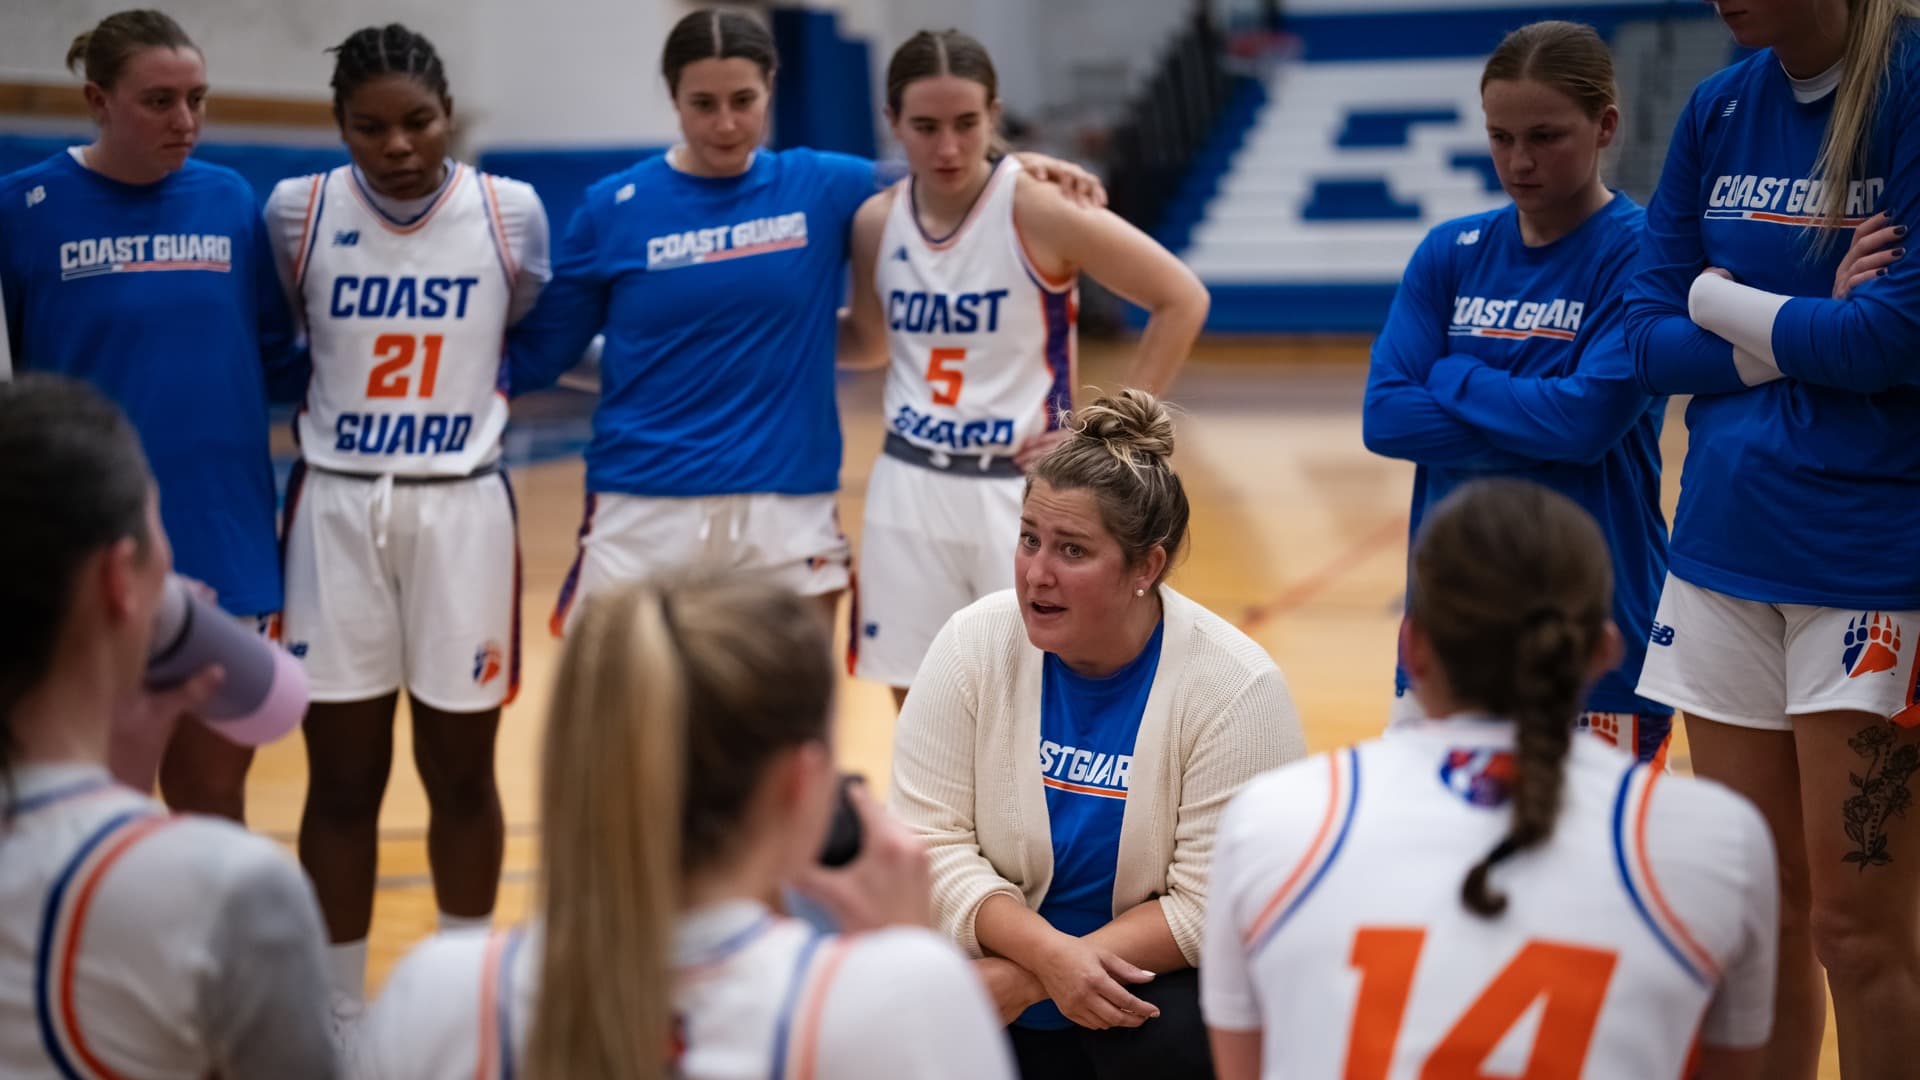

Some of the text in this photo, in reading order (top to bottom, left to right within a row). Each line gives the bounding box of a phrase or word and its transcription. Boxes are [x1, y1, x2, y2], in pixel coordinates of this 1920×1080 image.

[1708, 175, 1885, 215] COAST GURD
[60, 234, 231, 269] COAST GUARD
[647, 212, 807, 263] COAST GUARD
[331, 277, 478, 318] COAST
[890, 289, 1009, 333] COAST
[367, 334, 443, 398] 21
[926, 348, 966, 406] 5
[336, 414, 473, 454] GUARD
[893, 405, 1013, 449] GUARD
[1343, 927, 1618, 1080] 14
